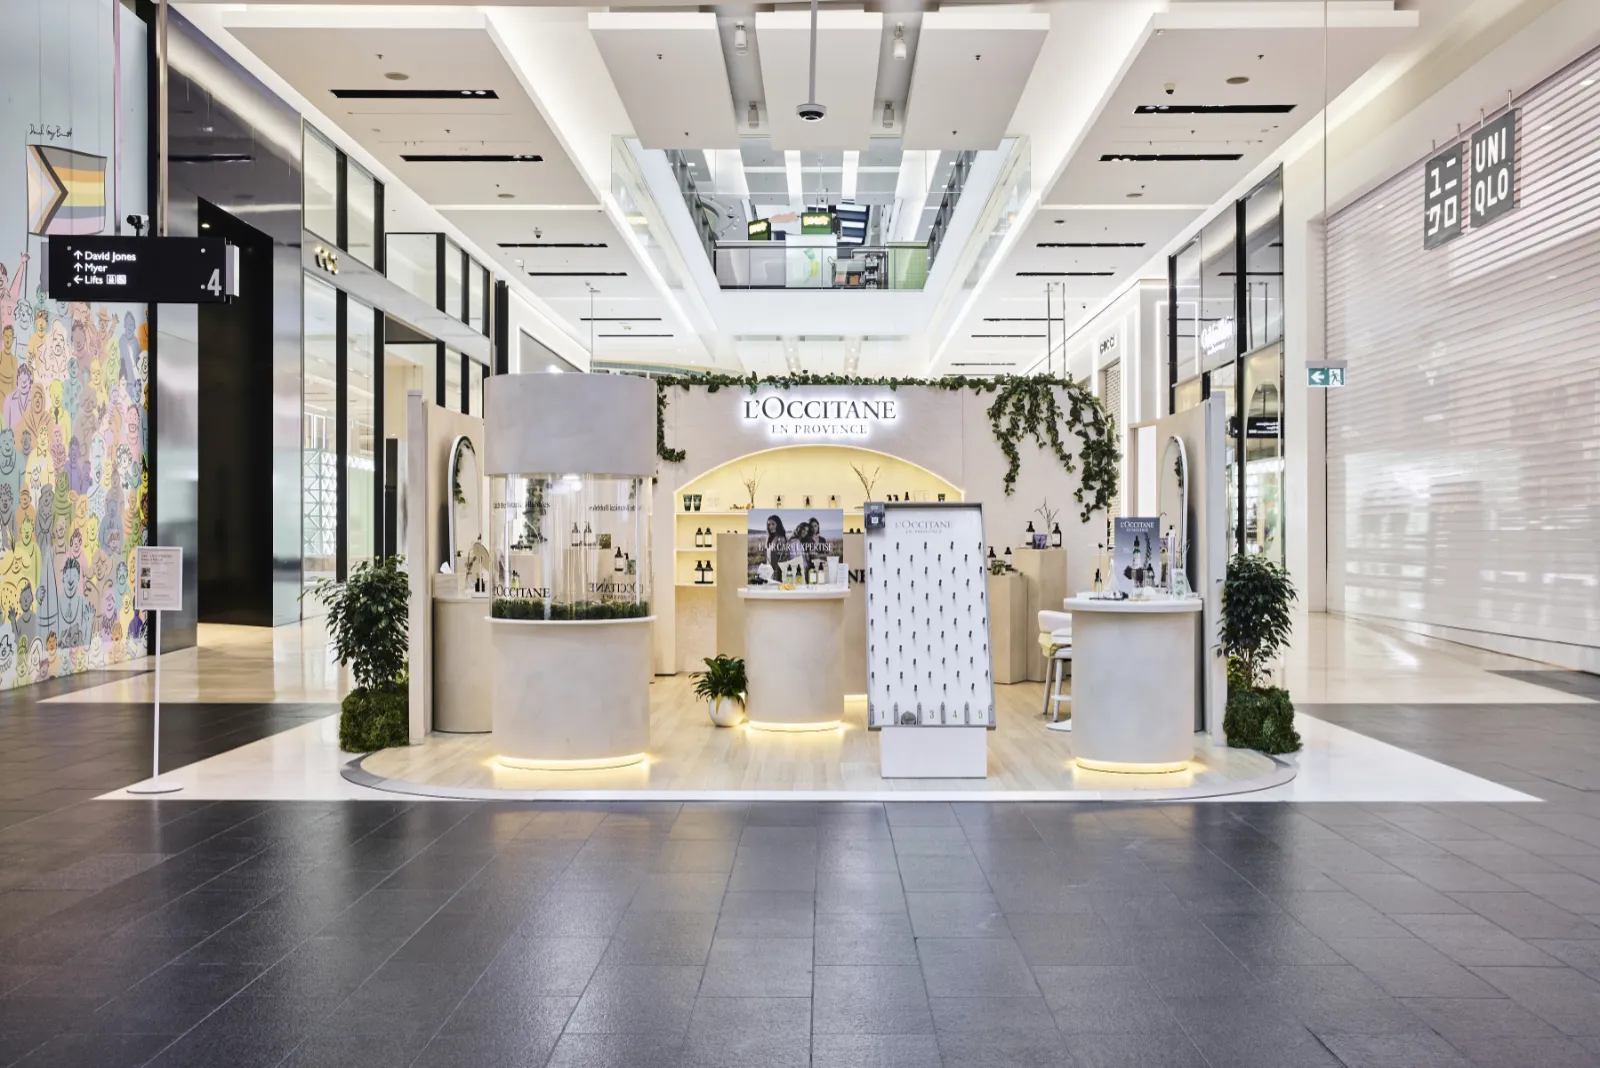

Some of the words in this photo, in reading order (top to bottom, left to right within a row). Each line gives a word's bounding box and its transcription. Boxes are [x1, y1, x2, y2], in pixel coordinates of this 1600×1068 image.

[1476, 127, 1506, 173] UNI
[1475, 168, 1508, 216] QLO
[84, 250, 110, 262] David
[111, 251, 137, 263] Jones
[84, 263, 108, 274] Myer
[84, 274, 104, 285] Lifts
[207, 268, 222, 297] 4
[743, 396, 897, 420] L'OCCITANE
[772, 424, 788, 434] EN
[795, 424, 868, 434] PROVENCE
